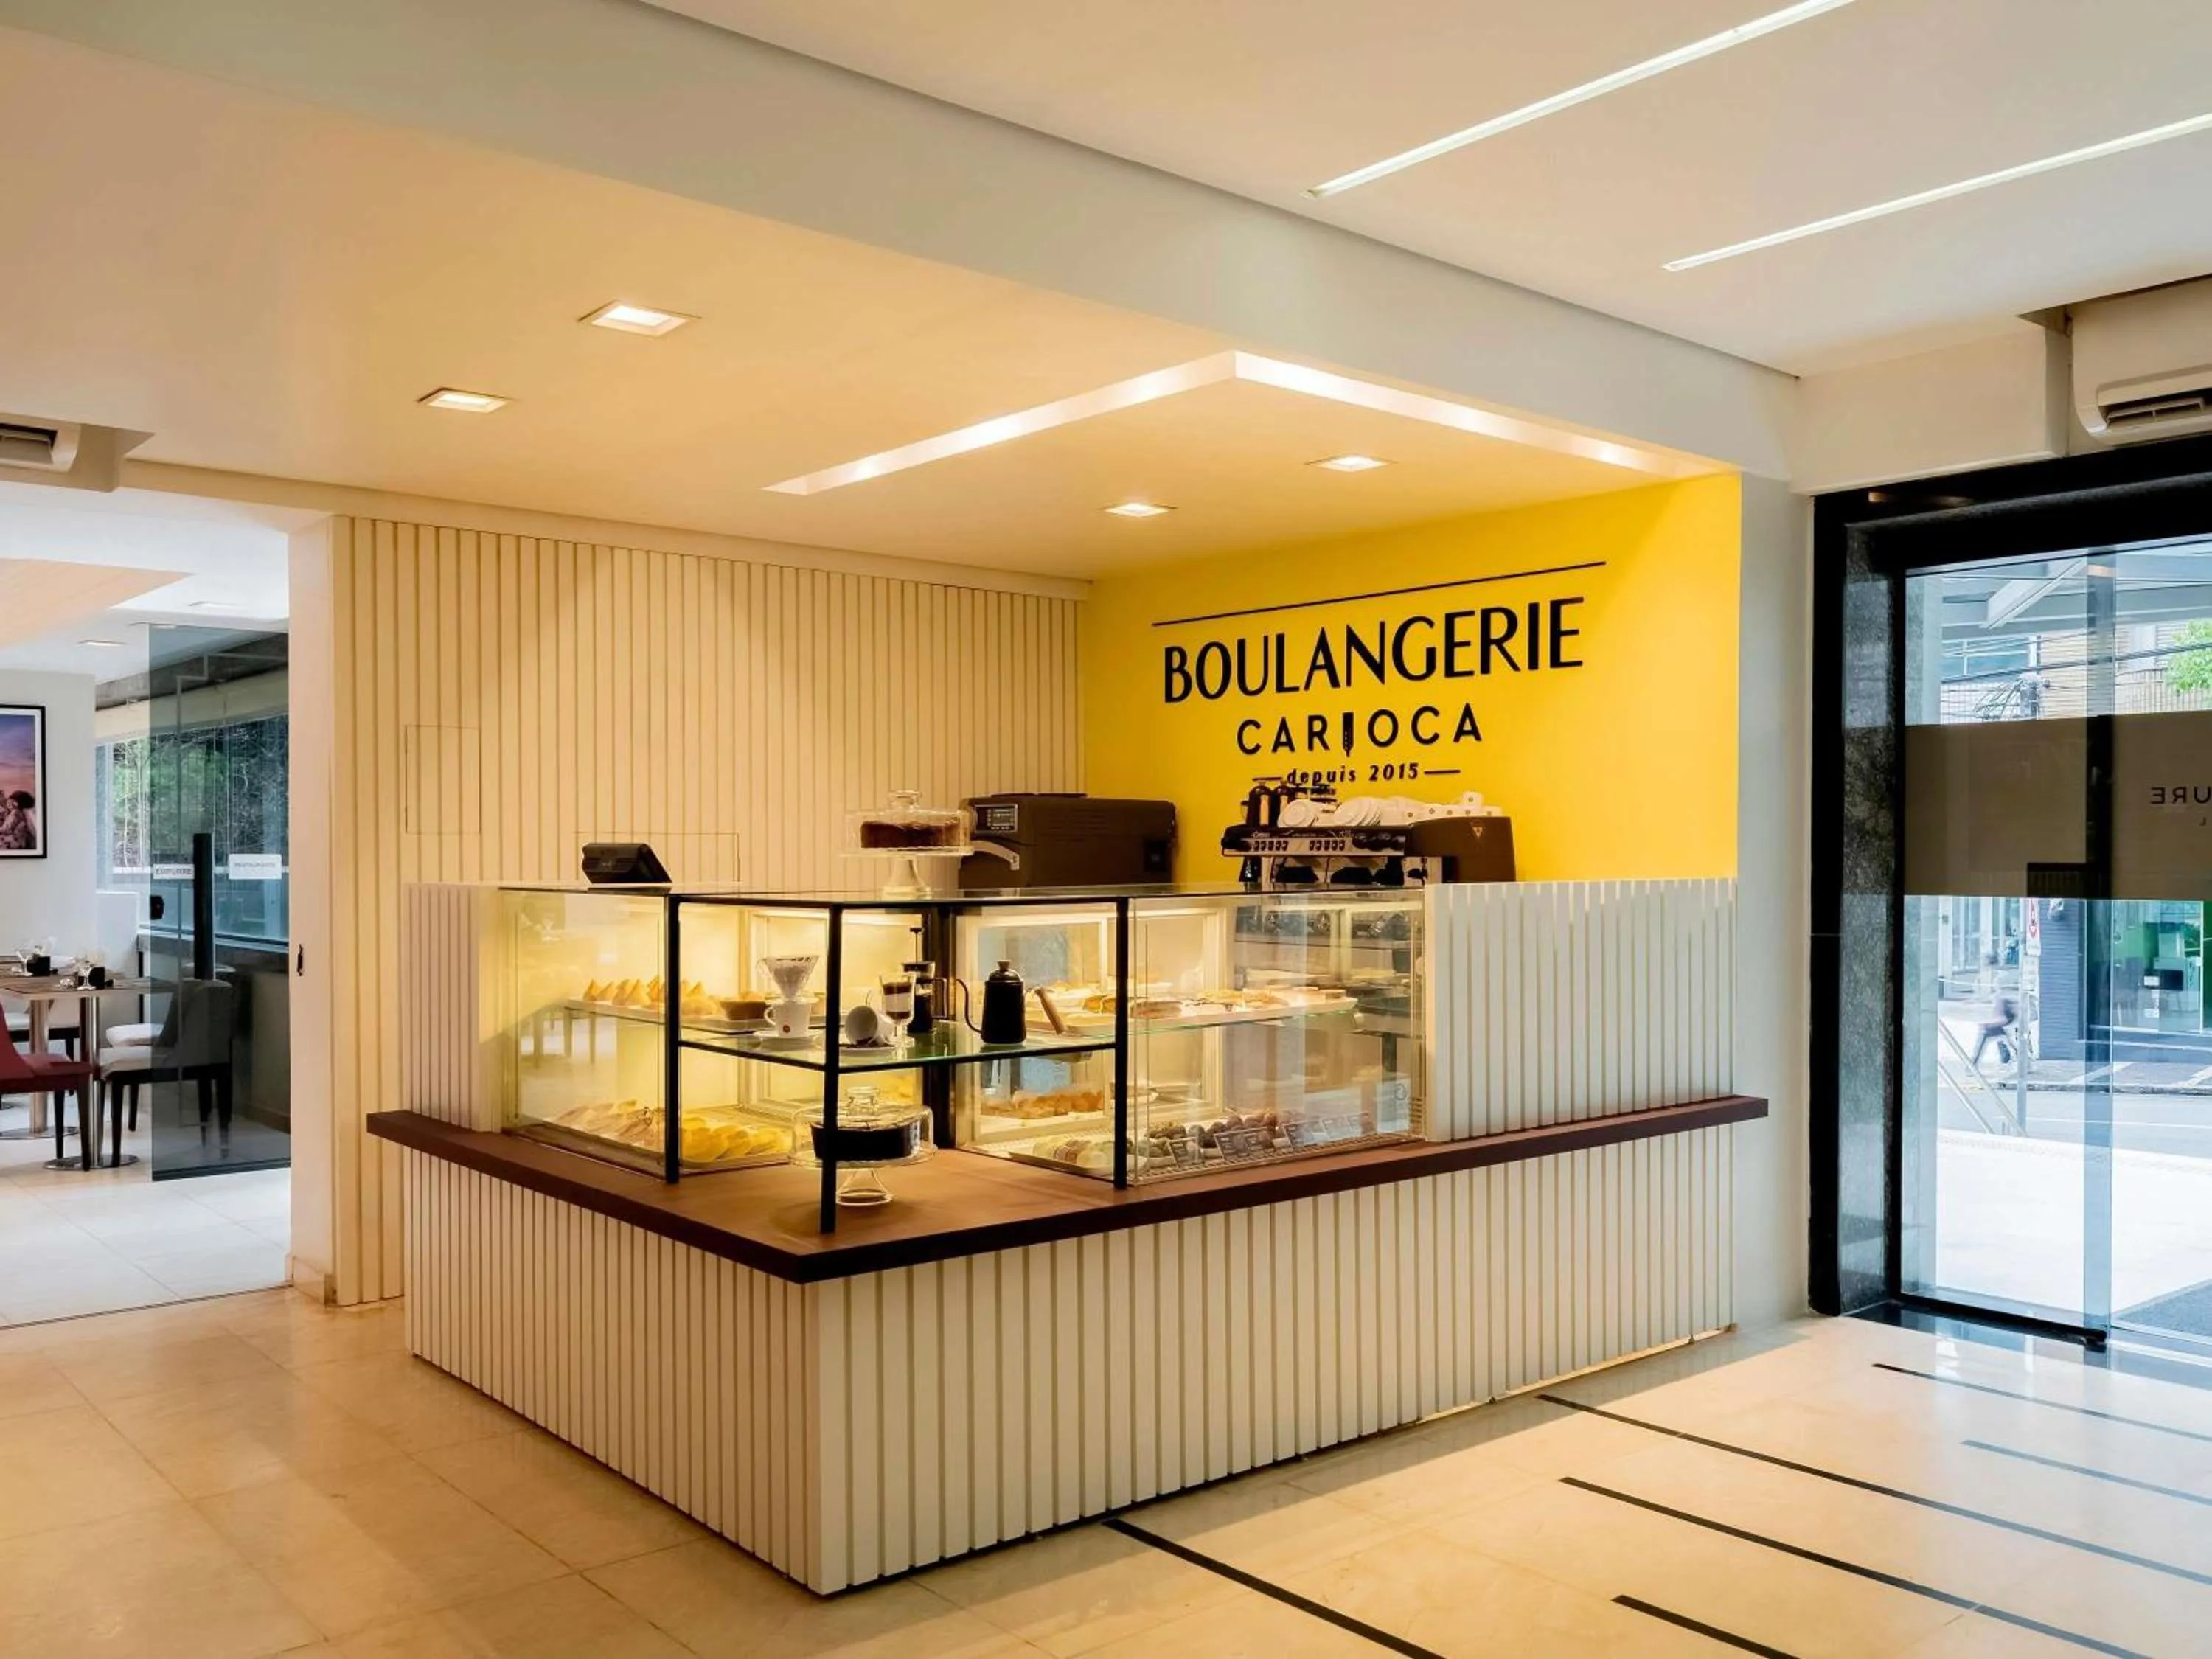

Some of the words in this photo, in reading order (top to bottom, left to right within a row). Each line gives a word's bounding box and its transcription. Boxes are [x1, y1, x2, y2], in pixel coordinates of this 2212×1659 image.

[1164, 597, 1584, 703] BOULANGERIE
[1237, 703, 1482, 757] CARIOCA
[1287, 765, 1356, 786] depuis
[1368, 762, 1419, 782] 2015
